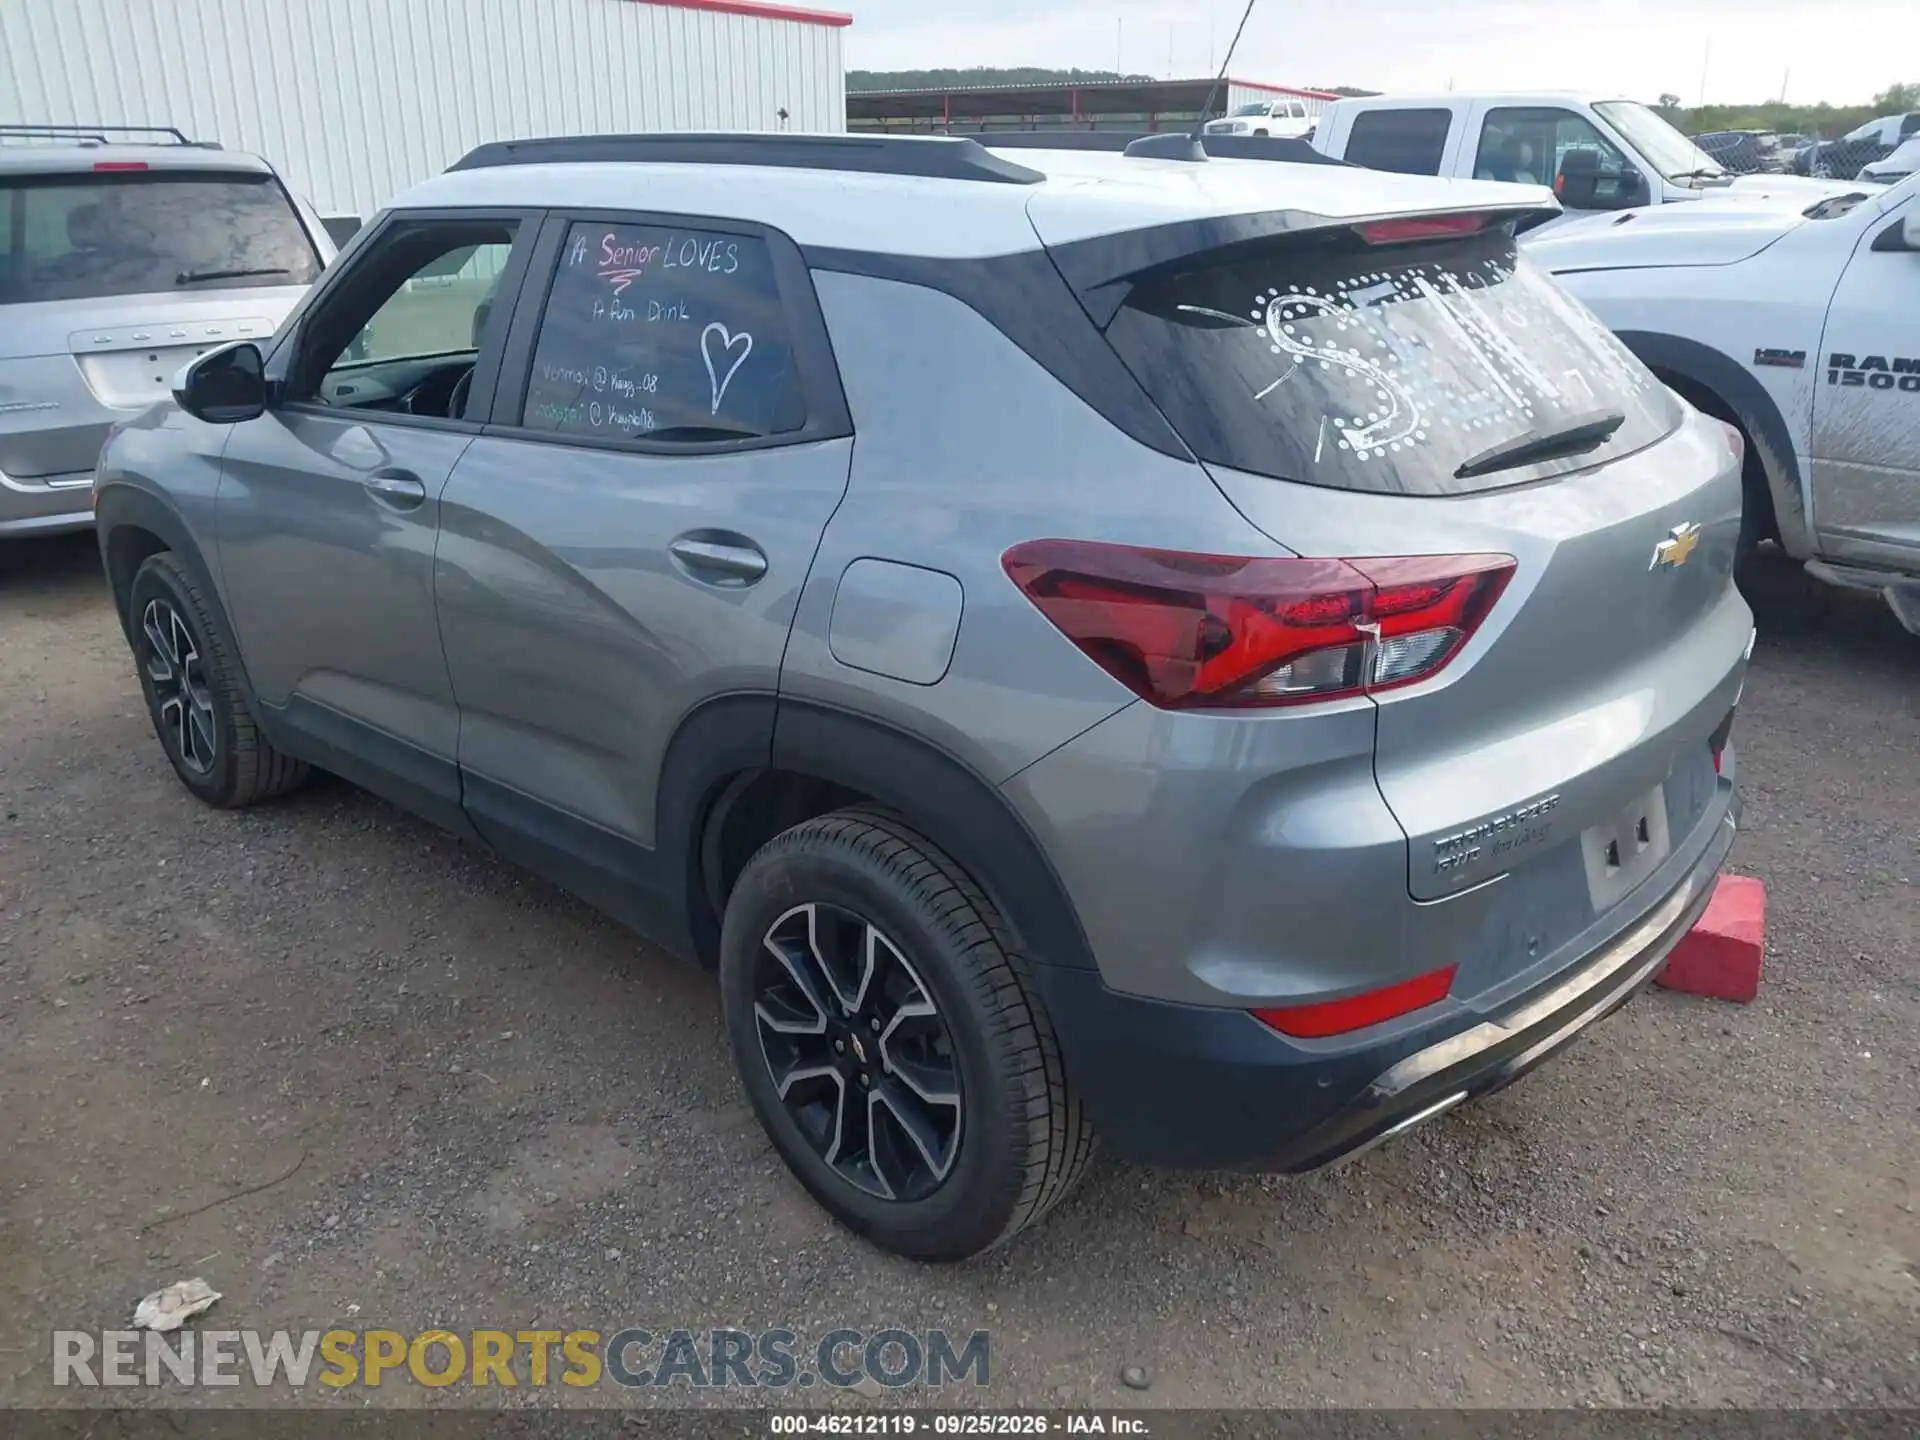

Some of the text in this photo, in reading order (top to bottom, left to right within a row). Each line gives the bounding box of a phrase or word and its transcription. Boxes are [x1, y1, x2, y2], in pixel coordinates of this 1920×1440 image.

[570, 232, 739, 273] A Senior LOVES
[647, 301, 690, 321] Drink
[1828, 352, 1920, 374] RAM
[1827, 369, 1920, 392] 1500
